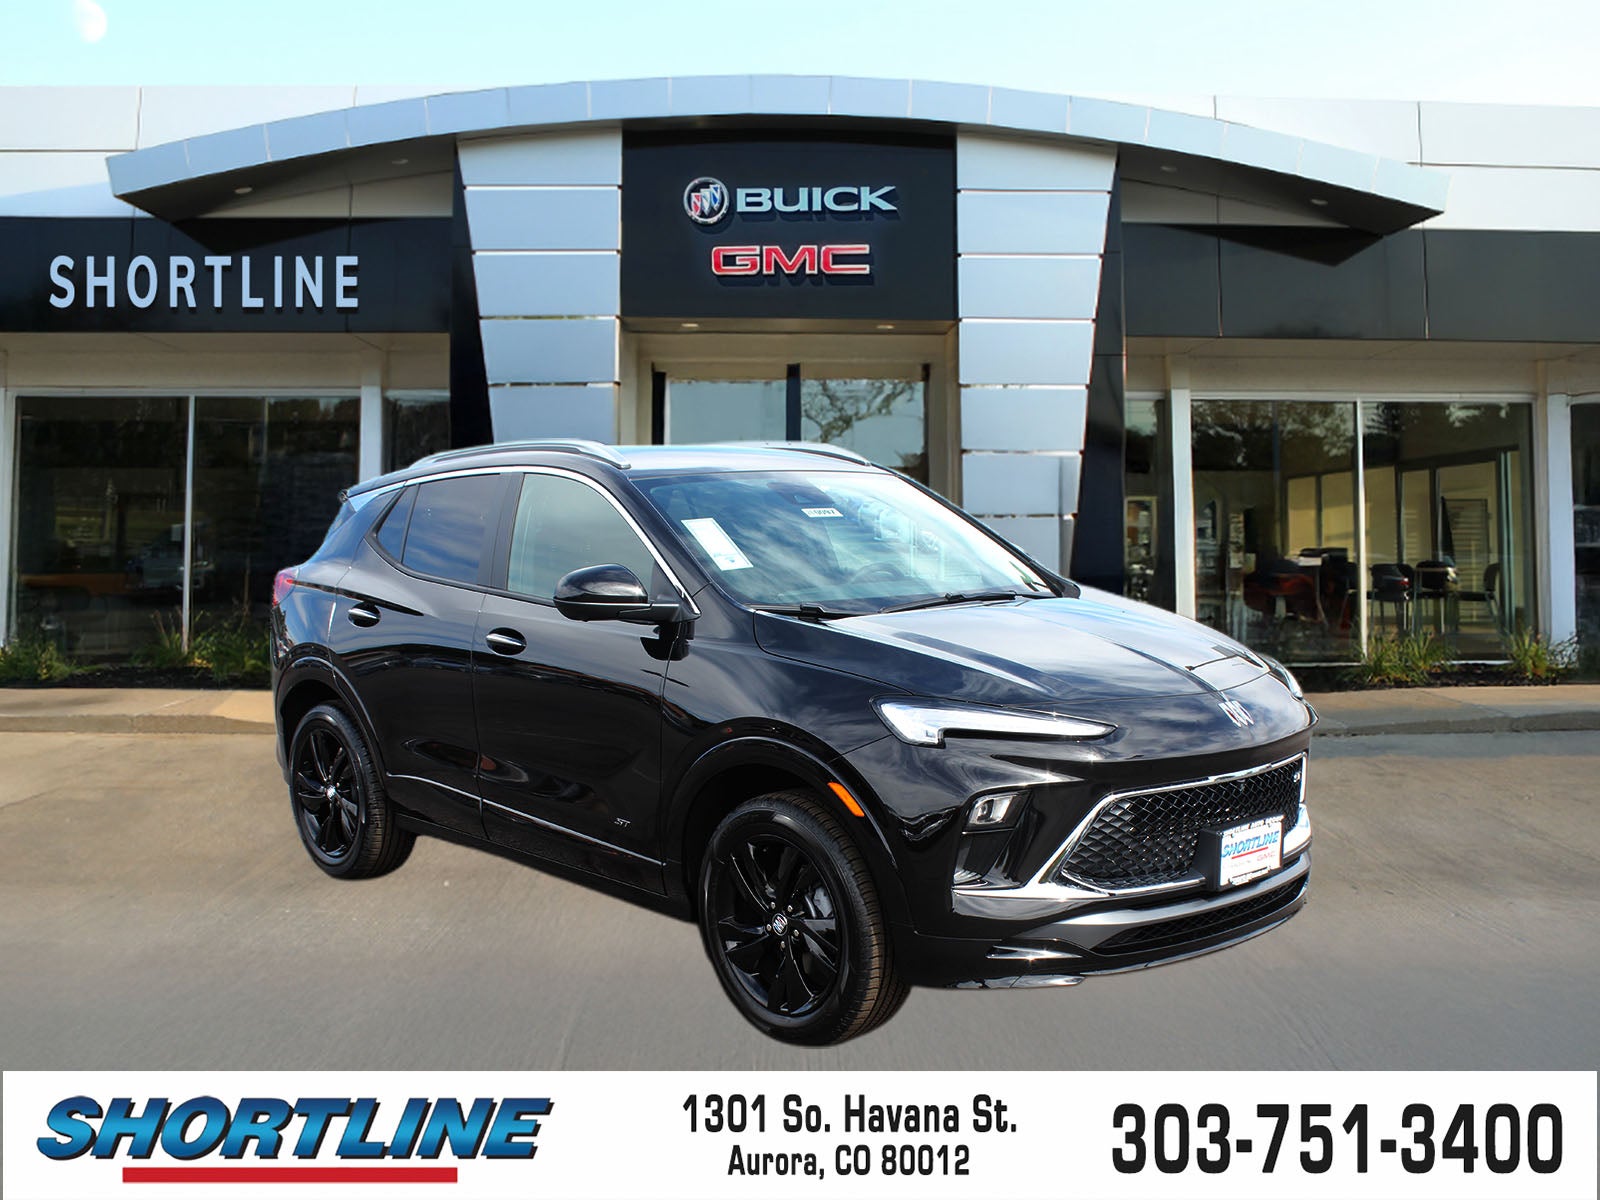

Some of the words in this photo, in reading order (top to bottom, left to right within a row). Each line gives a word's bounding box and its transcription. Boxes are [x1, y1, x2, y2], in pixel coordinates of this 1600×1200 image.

[736, 186, 898, 213] BUICK
[711, 244, 870, 275] GMC
[49, 255, 359, 308] SHORTLINE
[1221, 830, 1280, 858] SHORTLINE
